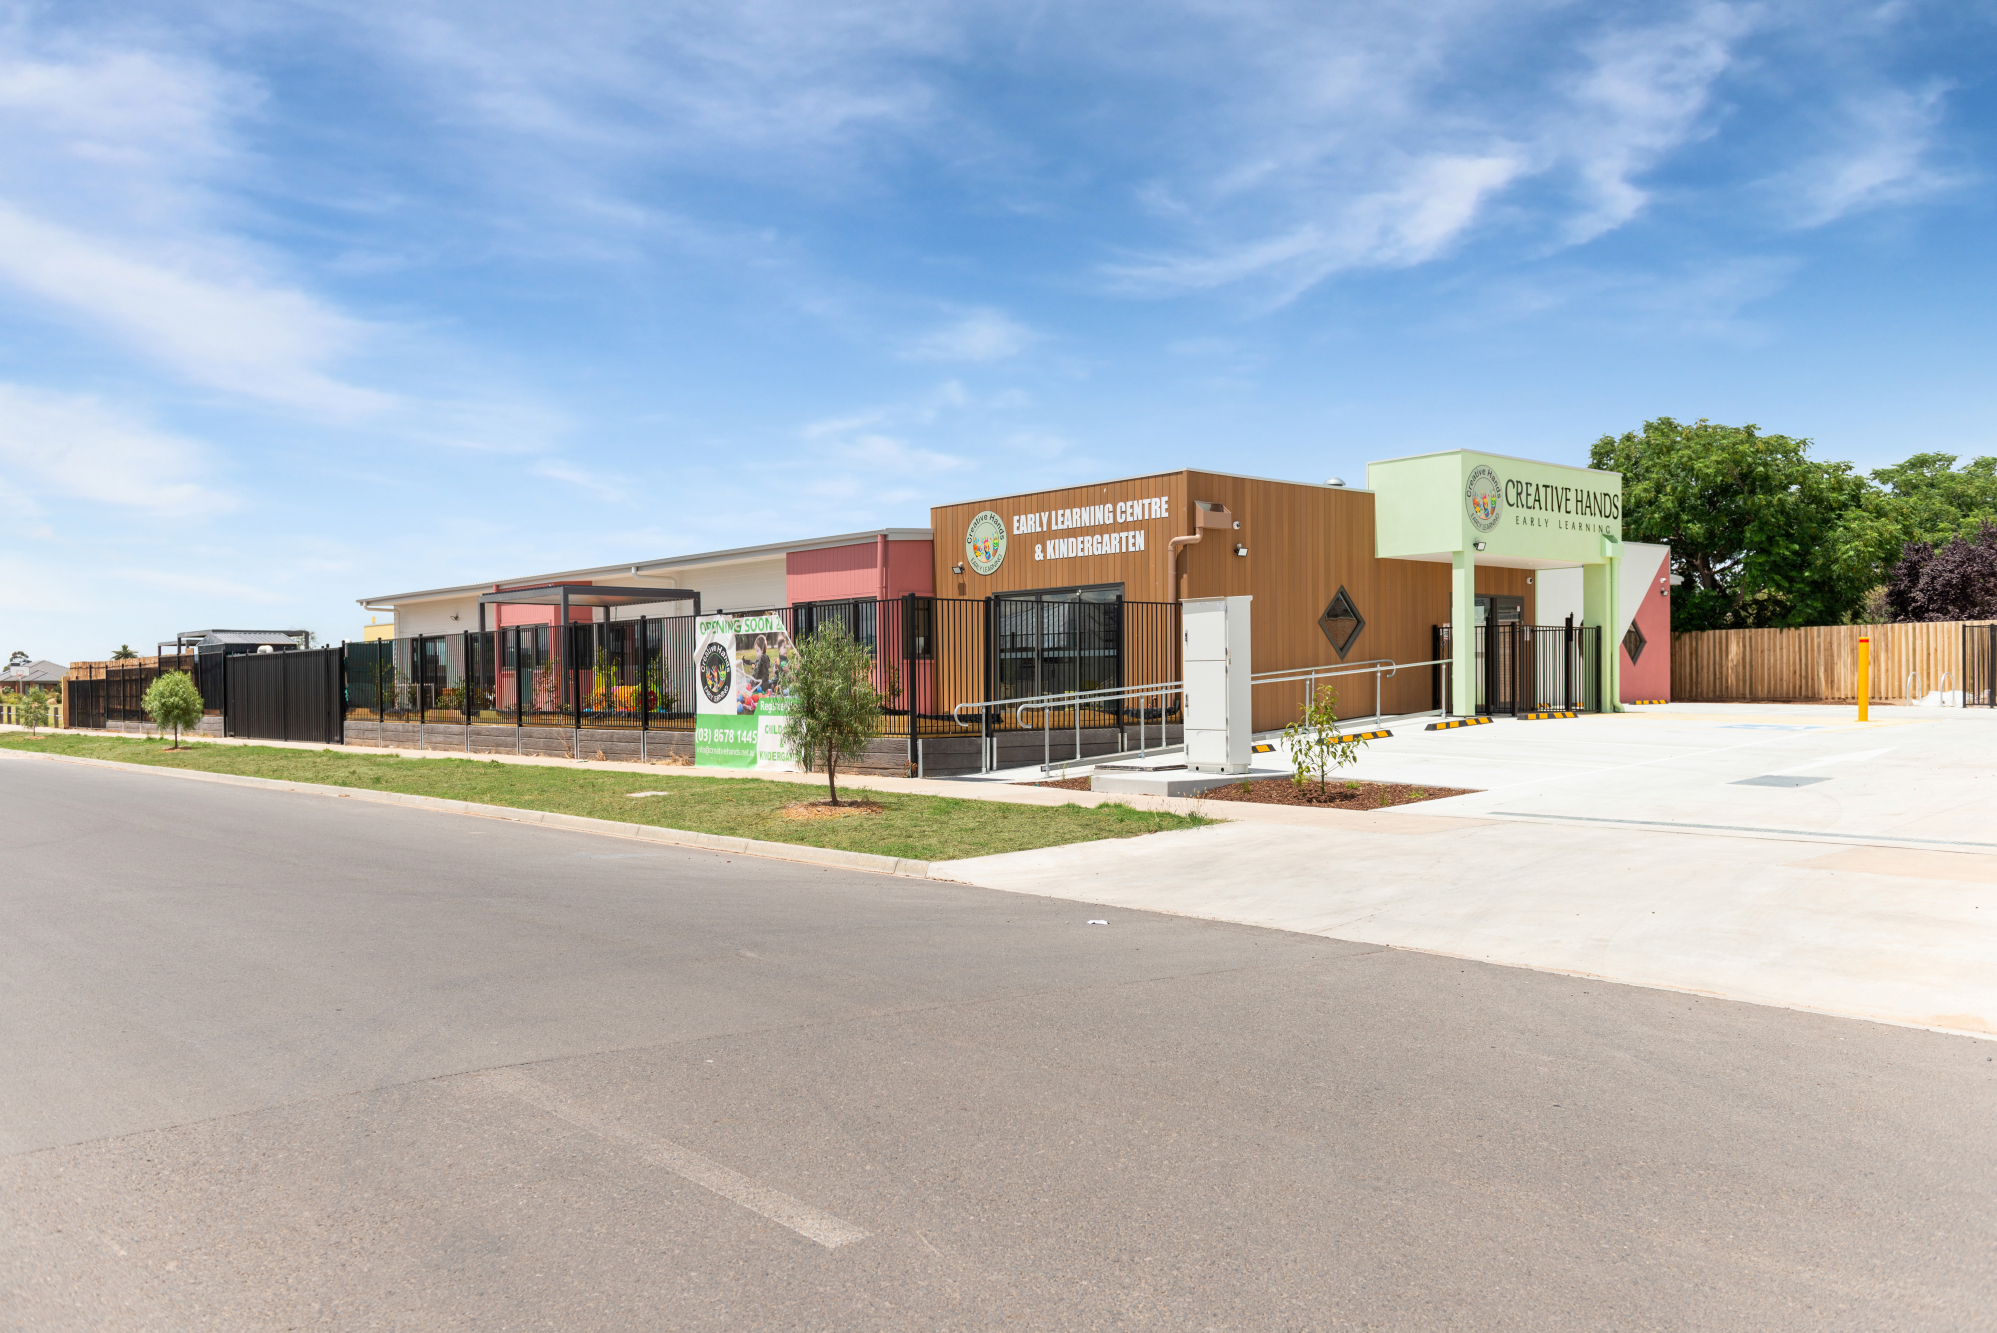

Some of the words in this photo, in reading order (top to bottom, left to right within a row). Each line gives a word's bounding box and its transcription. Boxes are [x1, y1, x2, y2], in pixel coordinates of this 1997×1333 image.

[1466, 468, 1486, 498] Creative
[1487, 469, 1501, 499] Hands
[1504, 478, 1571, 514] CREATIVE
[1575, 488, 1620, 520] HANDS
[966, 514, 988, 544] Creative
[989, 513, 1005, 541] Hands
[1013, 511, 1049, 535] EARLY
[1051, 503, 1113, 530] LEARNING
[1116, 496, 1169, 523] CENTRE
[1515, 515, 1549, 528] EARLY
[1558, 520, 1611, 534] LEARNING
[1034, 544, 1044, 561] &
[1046, 530, 1145, 560] KINDERGARTEN
[982, 553, 1003, 573] LEARNING
[700, 619, 742, 636] OPENING
[744, 617, 773, 632] SOON
[696, 728, 711, 744] (03)
[713, 729, 734, 743] 8678
[737, 730, 758, 744] 1445
